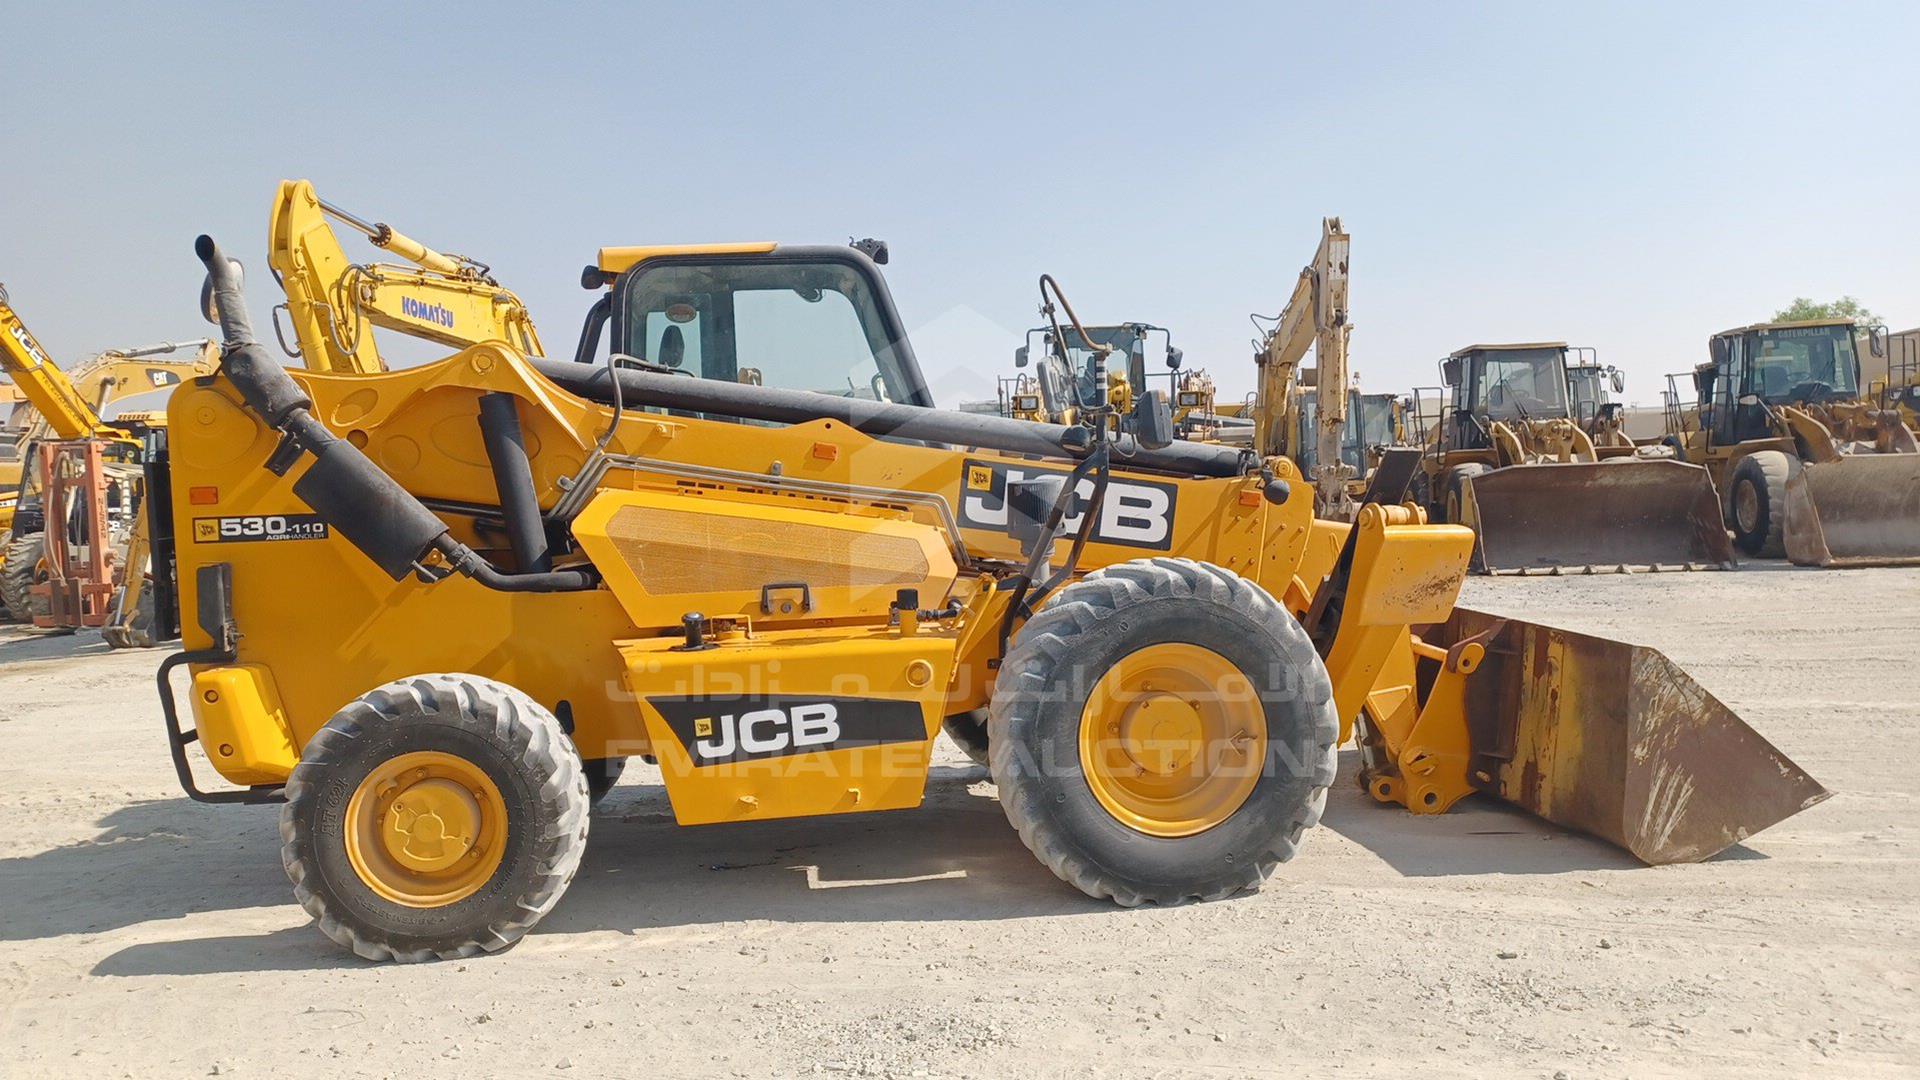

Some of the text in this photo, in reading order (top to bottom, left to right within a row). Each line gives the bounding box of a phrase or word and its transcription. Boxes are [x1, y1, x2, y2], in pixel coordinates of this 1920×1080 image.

[401, 295, 454, 328] KOMATSU
[153, 371, 168, 386] CAT
[220, 516, 324, 536] 530-110
[266, 533, 325, 541] AGRIHANDLER
[697, 703, 840, 759] JCB
